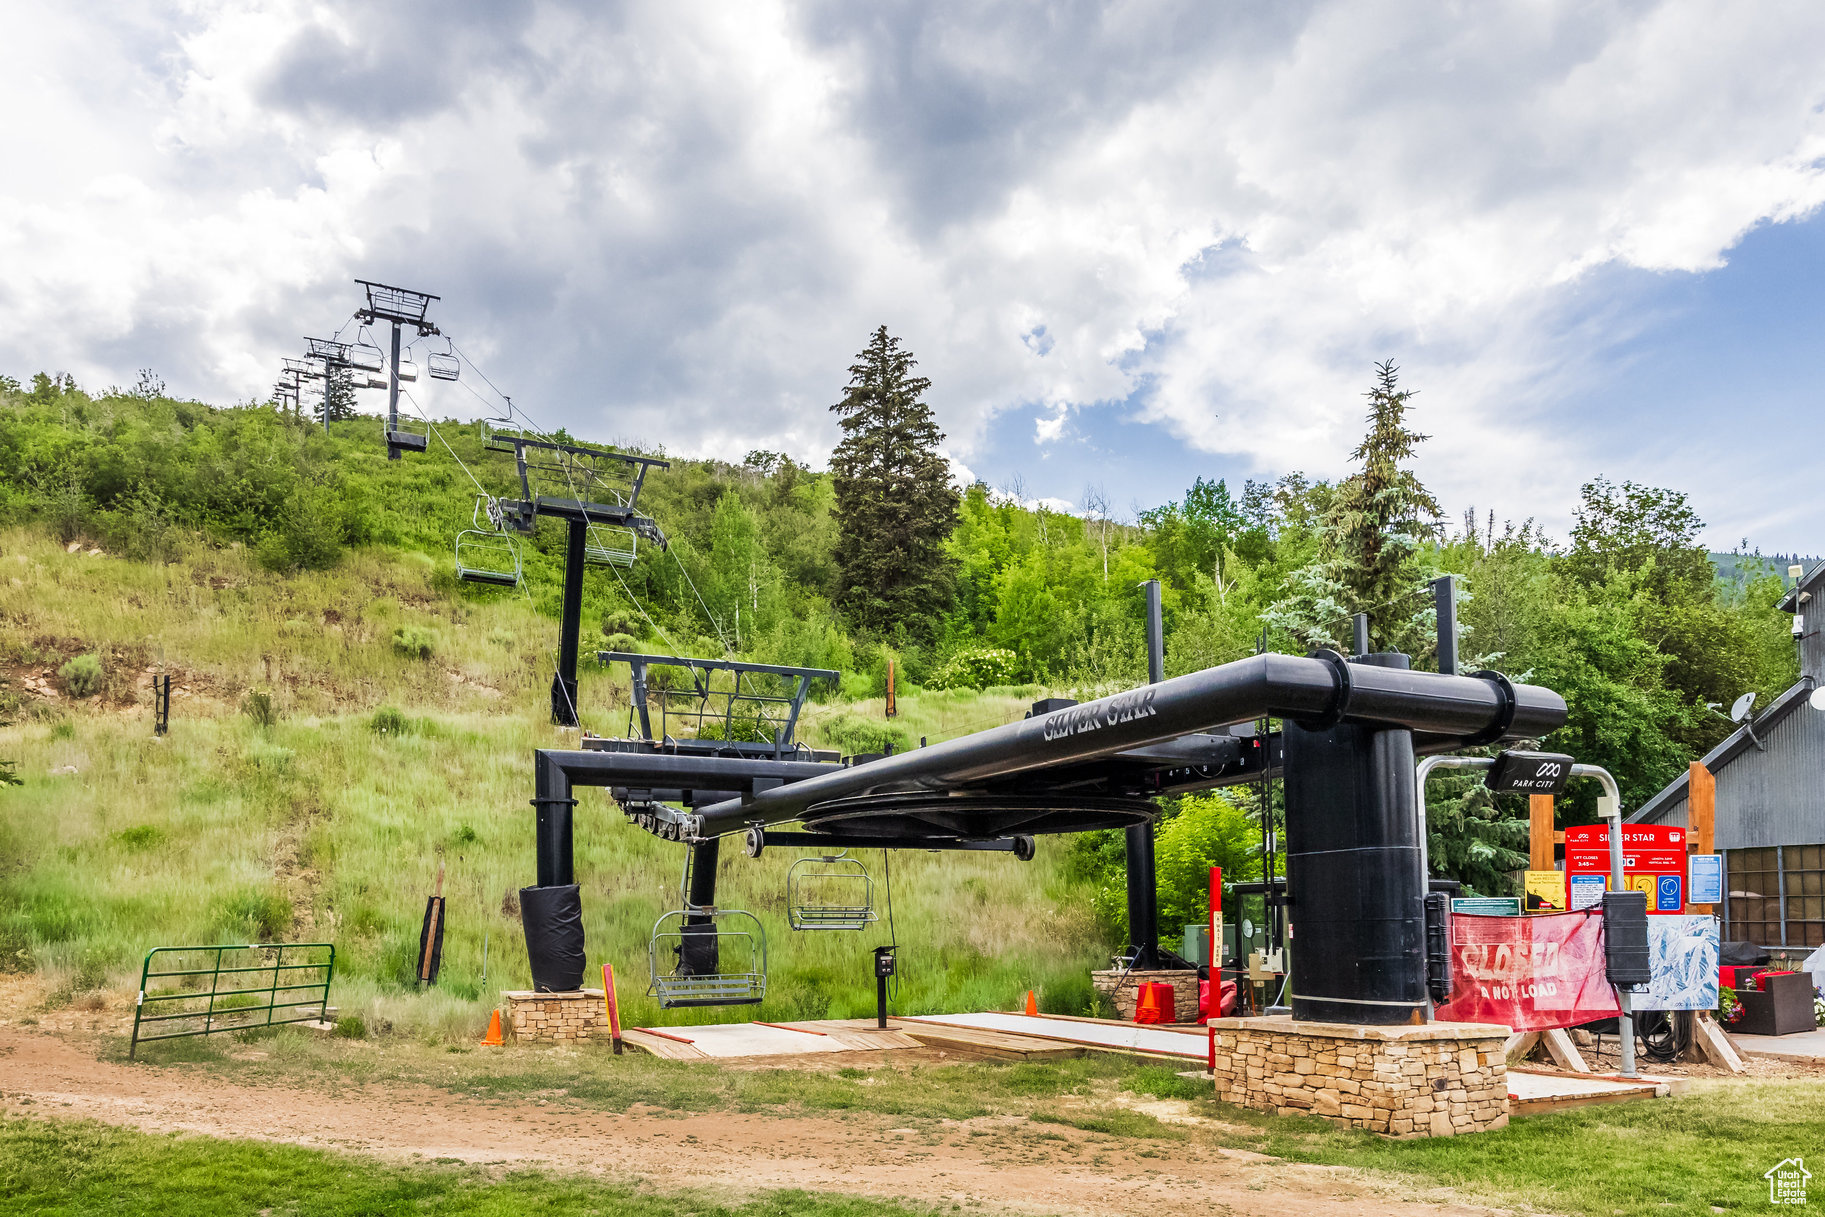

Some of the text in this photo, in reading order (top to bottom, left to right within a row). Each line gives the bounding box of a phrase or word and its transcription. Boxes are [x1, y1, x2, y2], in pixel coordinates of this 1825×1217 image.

[1043, 689, 1157, 741] SILVER STAR
[1512, 779, 1555, 788] PARK CITY
[1599, 833, 1655, 842] SIER STAR
[1461, 943, 1559, 980] CLOSED
[1492, 985, 1518, 1000] NOT
[1521, 983, 1558, 999] LOAD
